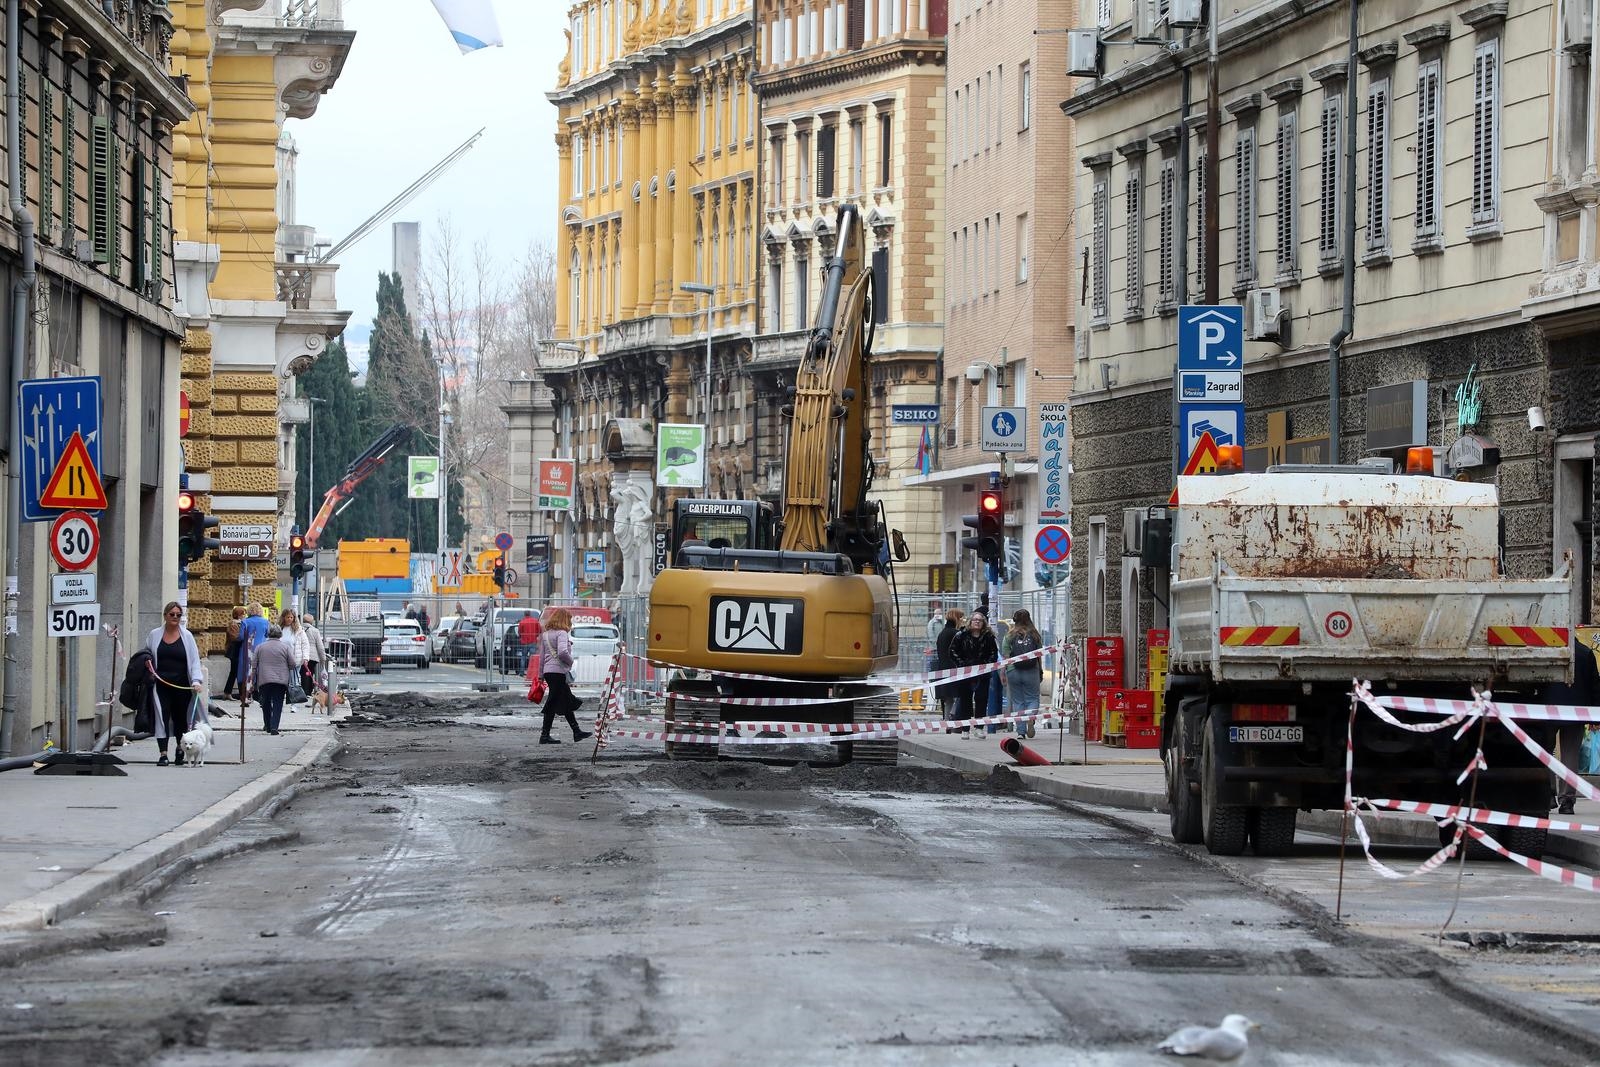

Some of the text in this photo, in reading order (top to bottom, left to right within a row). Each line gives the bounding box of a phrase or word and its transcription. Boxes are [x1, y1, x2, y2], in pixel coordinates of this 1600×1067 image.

[1199, 322, 1226, 361] P
[1206, 381, 1240, 394] Zagrad
[1042, 404, 1065, 412] AUTO
[894, 410, 937, 420] SEIKO
[1040, 413, 1067, 421] ŠKOLA
[1042, 421, 1065, 509] Madcar
[688, 503, 742, 515] CATERPILLAR
[222, 529, 249, 539] Bonavia
[62, 527, 90, 556] 30
[220, 545, 248, 557] Muzeji
[65, 579, 83, 587] VOZILA
[59, 588, 89, 598] GRADILIŠTA
[52, 609, 95, 632] 50m
[715, 600, 794, 651] CAT
[1332, 619, 1346, 631] 80
[1238, 729, 1301, 741] RI 604-GG
